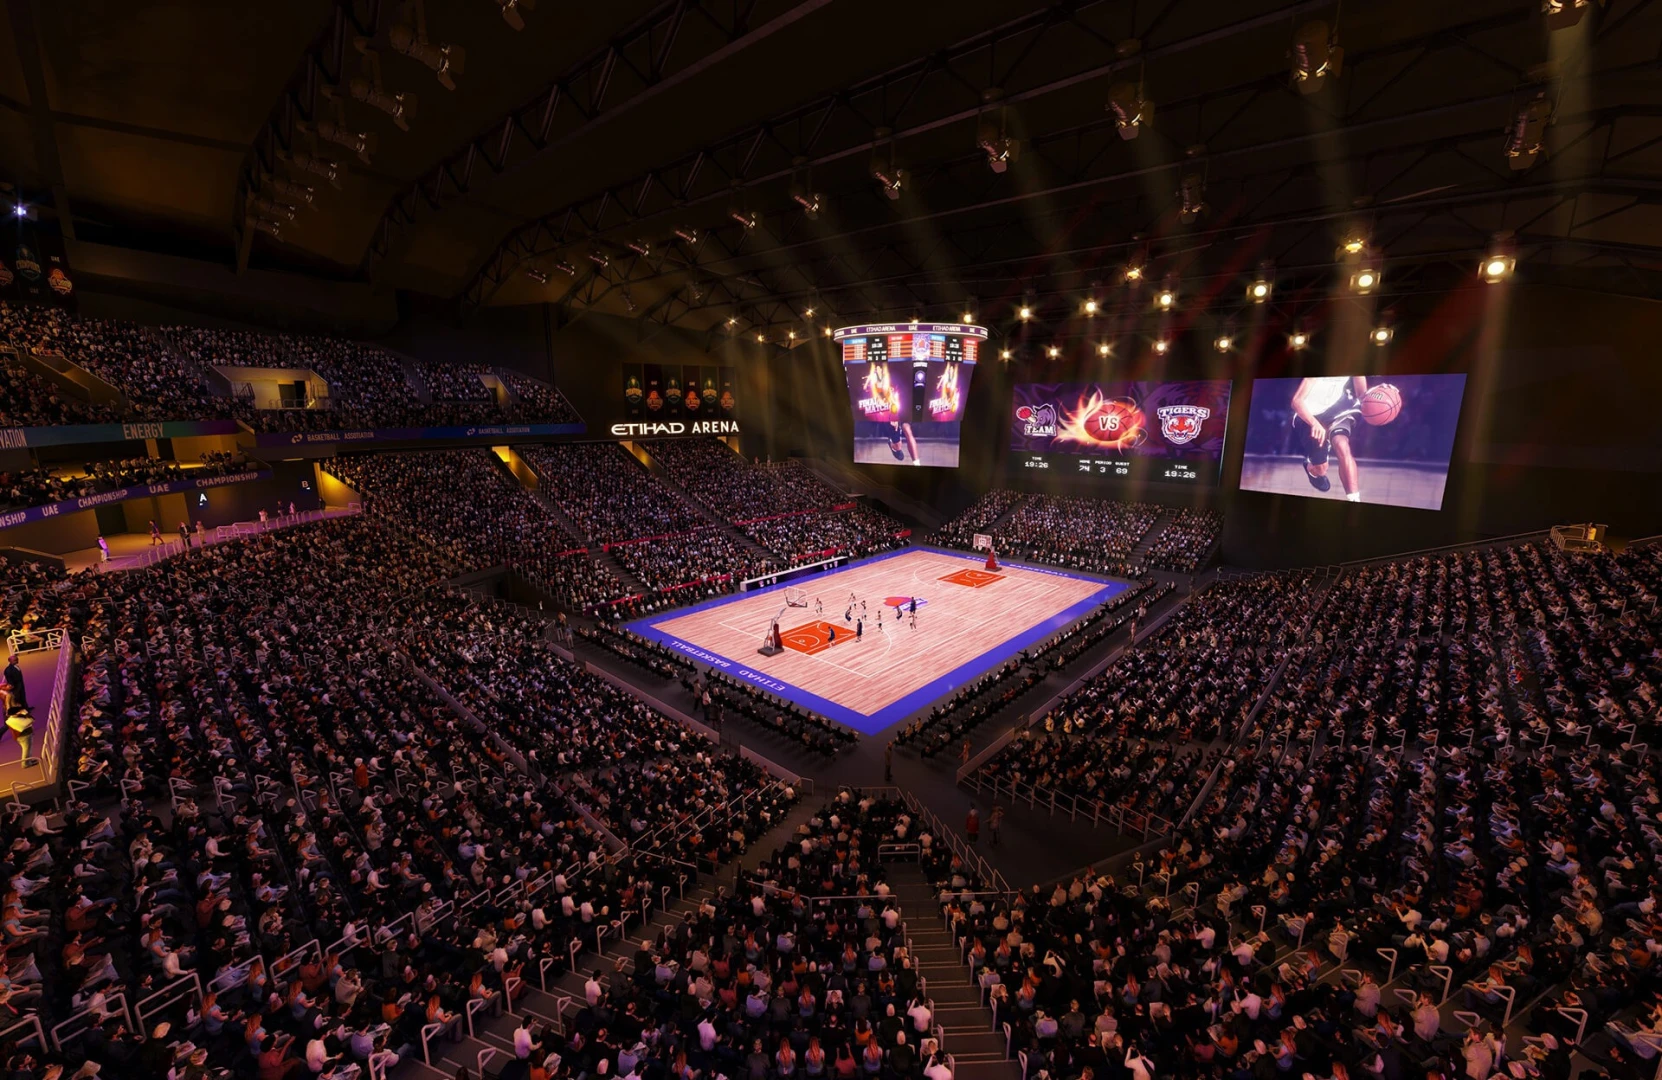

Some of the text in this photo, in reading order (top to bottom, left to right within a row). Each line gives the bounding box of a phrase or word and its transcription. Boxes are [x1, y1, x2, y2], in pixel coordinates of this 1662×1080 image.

[1159, 407, 1207, 418] TIGERS
[611, 420, 740, 436] ETIHAD ARENA
[1099, 415, 1120, 431] VS
[122, 422, 164, 440] ENERGY
[1026, 425, 1054, 434] TEAM
[306, 432, 341, 442] BASKETBALL
[1115, 467, 1128, 475] 69
[1164, 470, 1196, 478] 19:26
[41, 504, 59, 517] UAE
[77, 489, 128, 508] CHAMPIONSHIP
[148, 483, 170, 494] UAE
[195, 472, 259, 488] CHAMPIONSHIP
[199, 492, 207, 503] A
[671, 640, 786, 692] ETIHAD BASKETBALL
